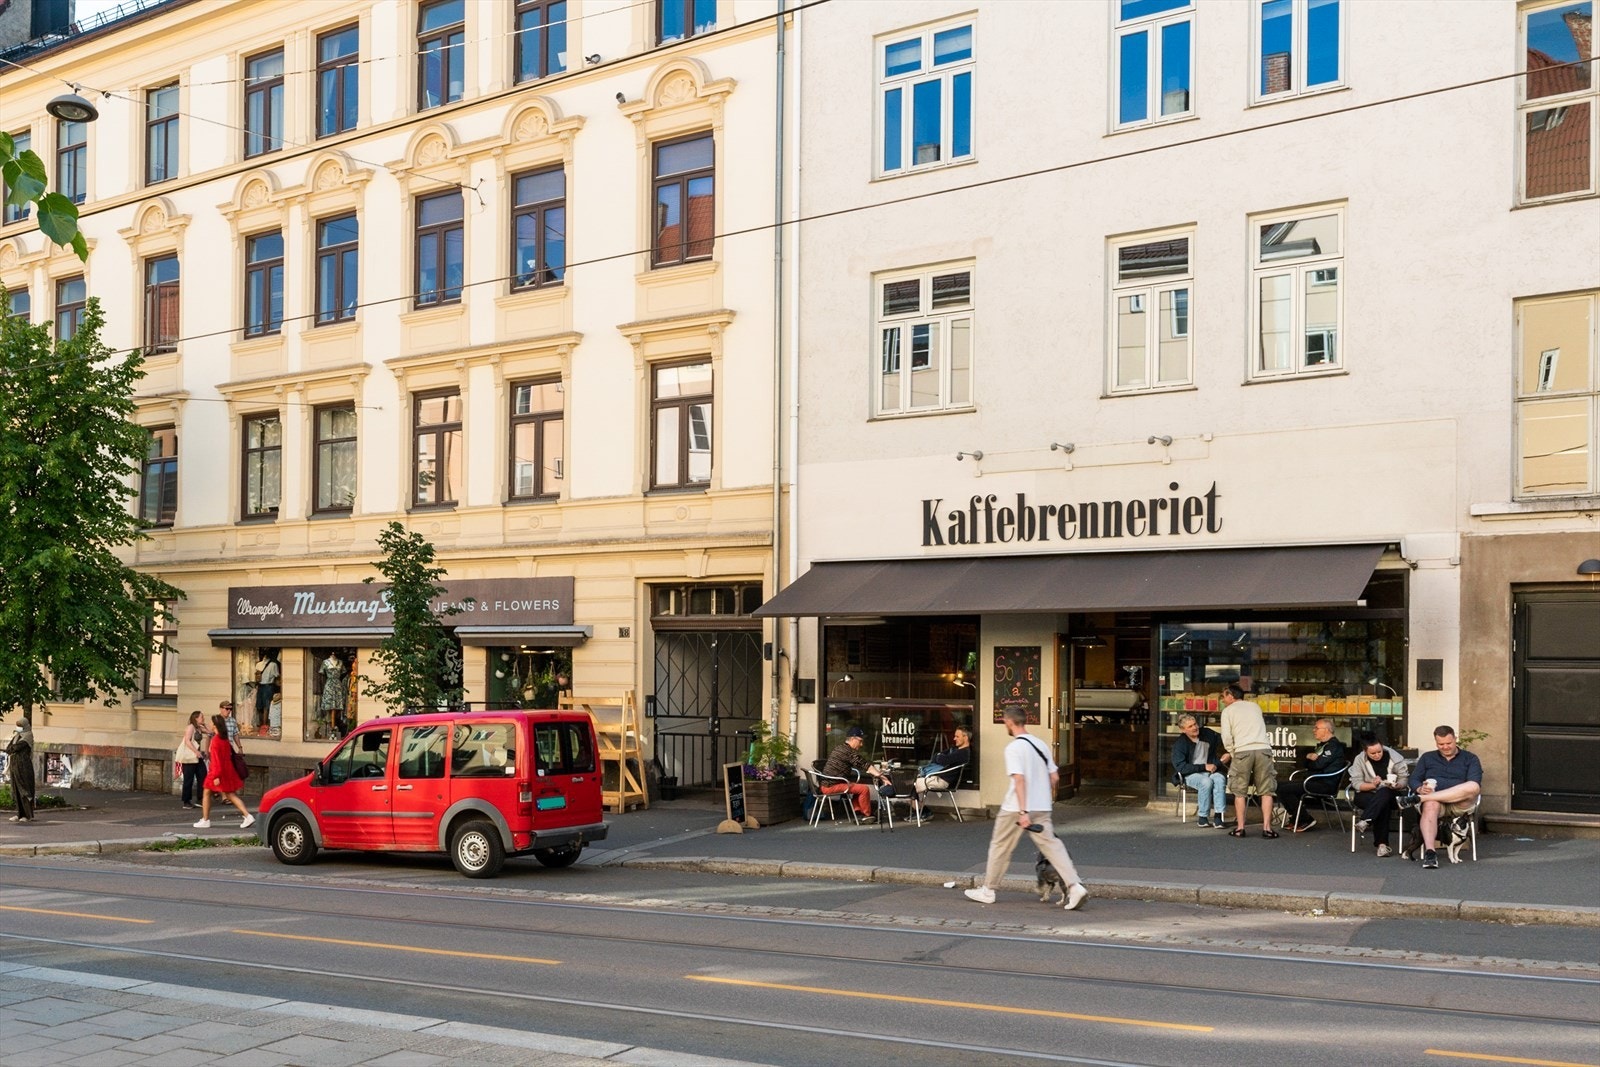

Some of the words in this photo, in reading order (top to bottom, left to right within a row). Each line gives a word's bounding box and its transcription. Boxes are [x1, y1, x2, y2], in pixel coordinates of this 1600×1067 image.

[921, 480, 1223, 547] Kaffebrenneriet
[434, 601, 475, 612] JEANS
[481, 601, 489, 612] &
[495, 599, 560, 611] FLOWERS
[881, 717, 915, 735] Kaffe
[881, 735, 915, 745] brenneriet
[1266, 727, 1297, 747] affe
